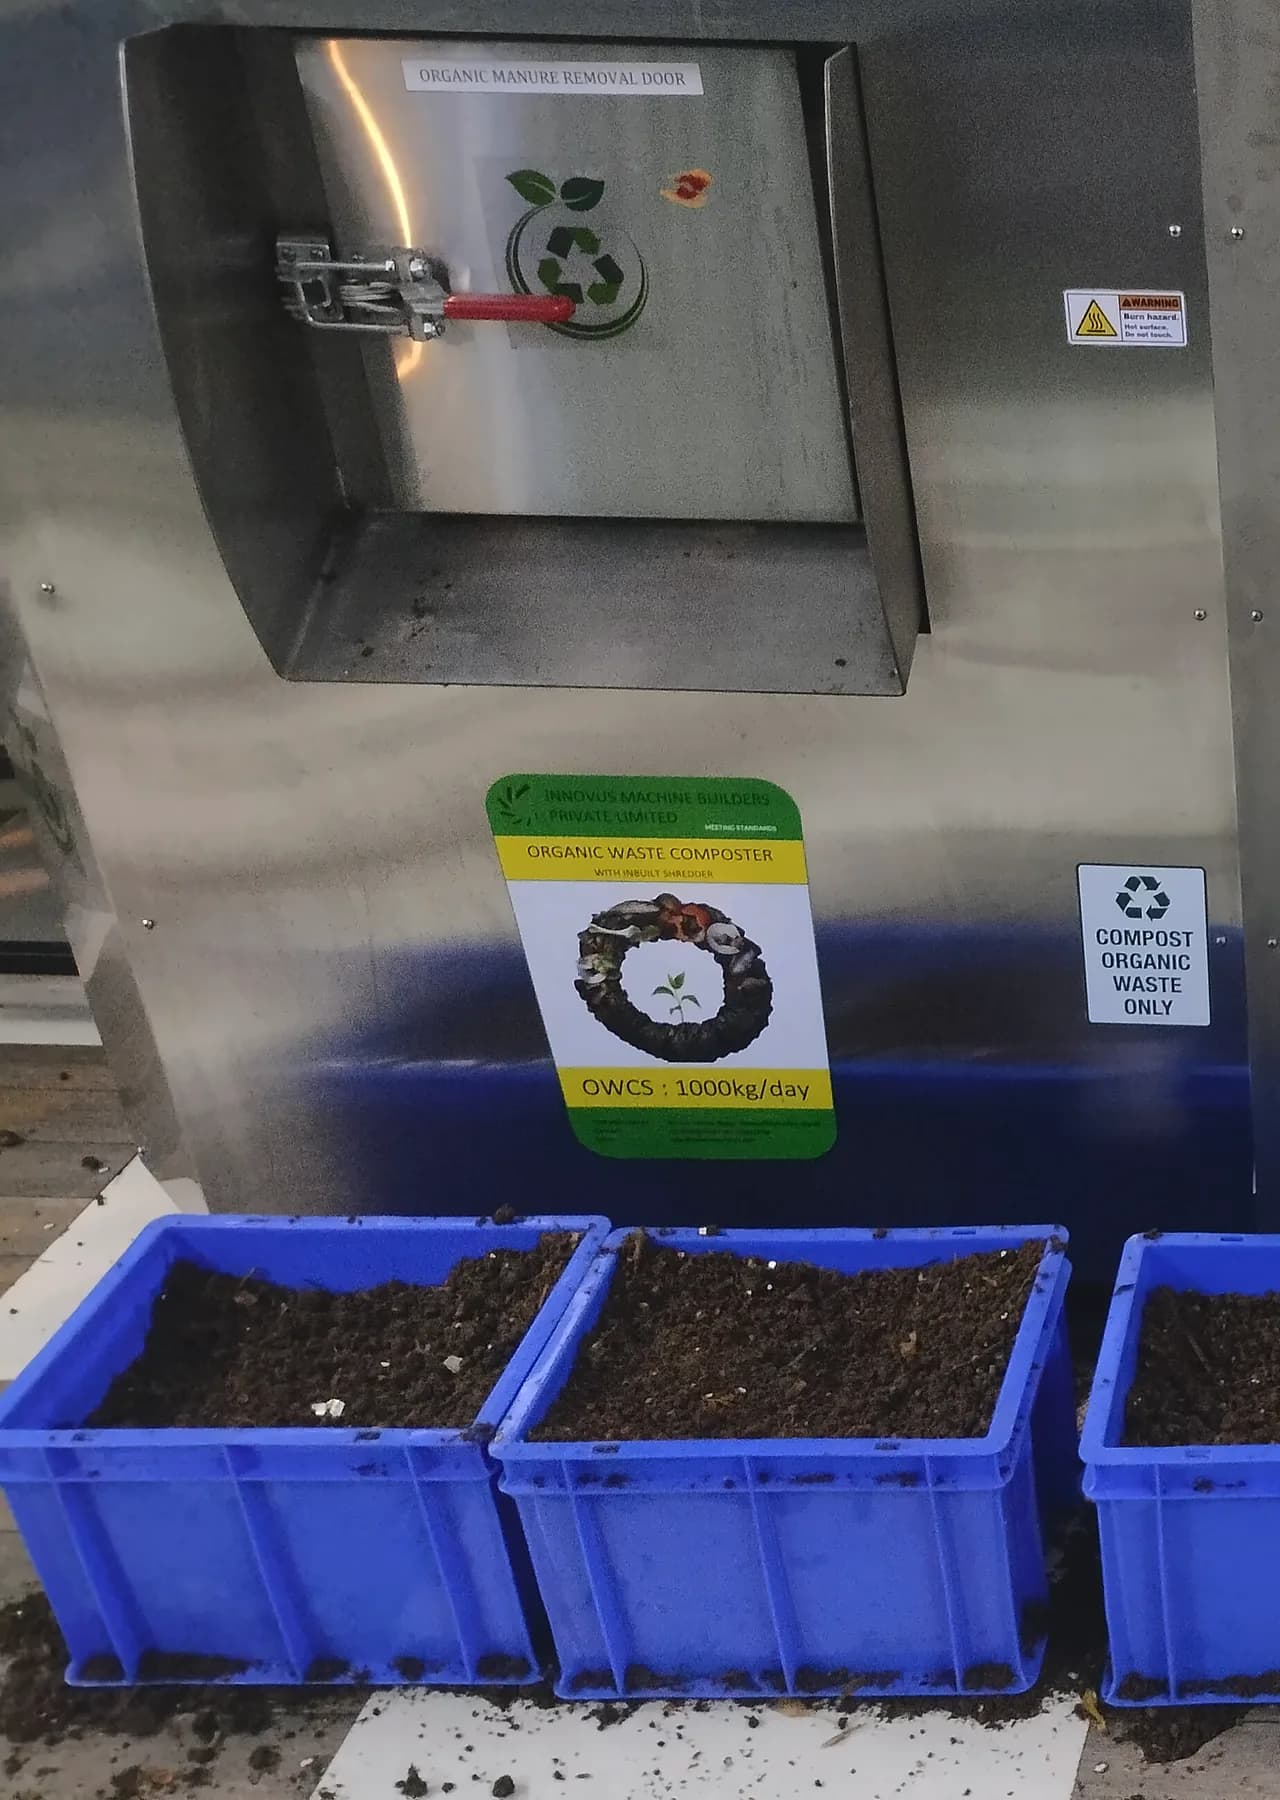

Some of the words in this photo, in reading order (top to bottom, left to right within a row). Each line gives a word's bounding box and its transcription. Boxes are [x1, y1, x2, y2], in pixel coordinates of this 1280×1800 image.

[419, 67, 489, 83] ORGANIC
[492, 69, 559, 84] MANURE
[563, 71, 638, 85] REMOVAL
[642, 72, 687, 86] DOOR
[1132, 298, 1179, 308] WARNING
[545, 789, 616, 804] INNOVUS
[620, 790, 692, 805] MACHINE
[697, 791, 770, 806] BUILDERS
[549, 810, 611, 824] PRIVATE
[616, 811, 678, 825] LIMITED
[527, 845, 604, 859] ORGANIC
[607, 846, 666, 861] WASTE
[670, 847, 774, 862] COMPOSTER
[594, 868, 621, 877] WITH
[622, 868, 660, 878] INBUILT
[663, 869, 713, 879] SHREDDER
[1096, 928, 1194, 947] COMPOST
[1102, 952, 1191, 971] ORGANIC
[1113, 975, 1182, 993] WASTE
[1124, 998, 1173, 1016] ONLY
[582, 1078, 654, 1096] OWCS
[676, 1078, 810, 1101] 1000kg/day
